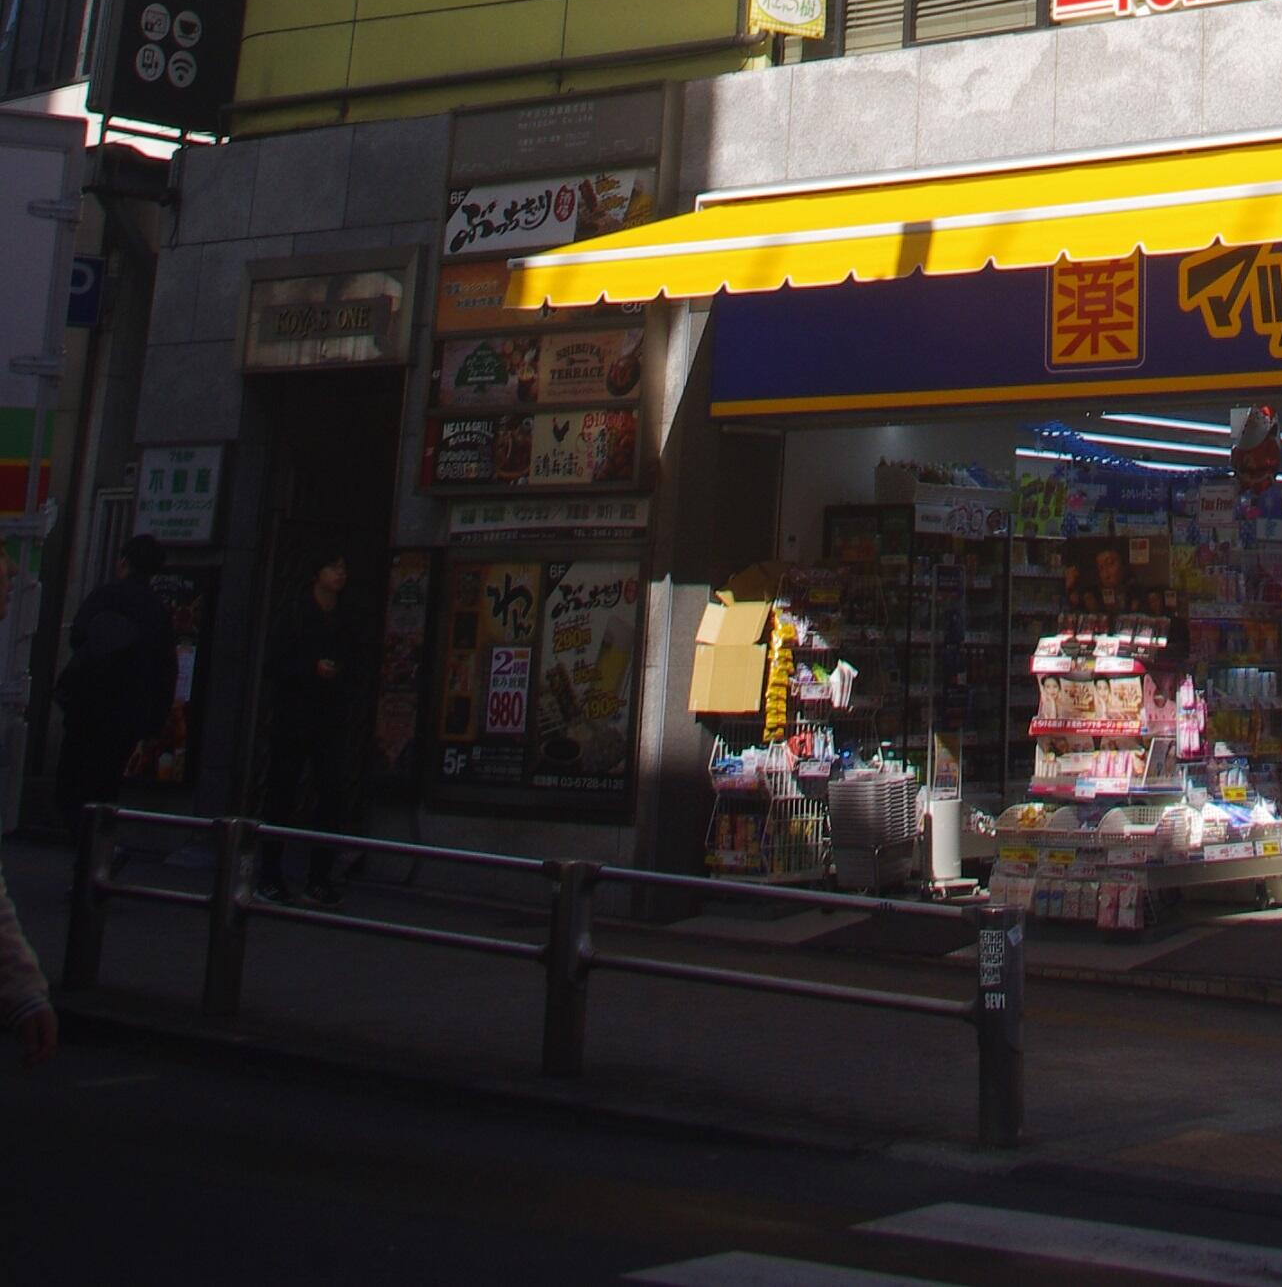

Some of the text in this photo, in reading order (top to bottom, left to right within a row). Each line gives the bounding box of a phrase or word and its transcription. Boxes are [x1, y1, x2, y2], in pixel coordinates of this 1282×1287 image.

[449, 191, 466, 205] 6F
[277, 305, 370, 338] KOYAS ONE
[1056, 258, 1140, 357] 薬
[550, 366, 605, 381] TERRACE
[149, 466, 213, 495] 不動産
[488, 690, 524, 728] 980
[442, 747, 467, 776] 5F
